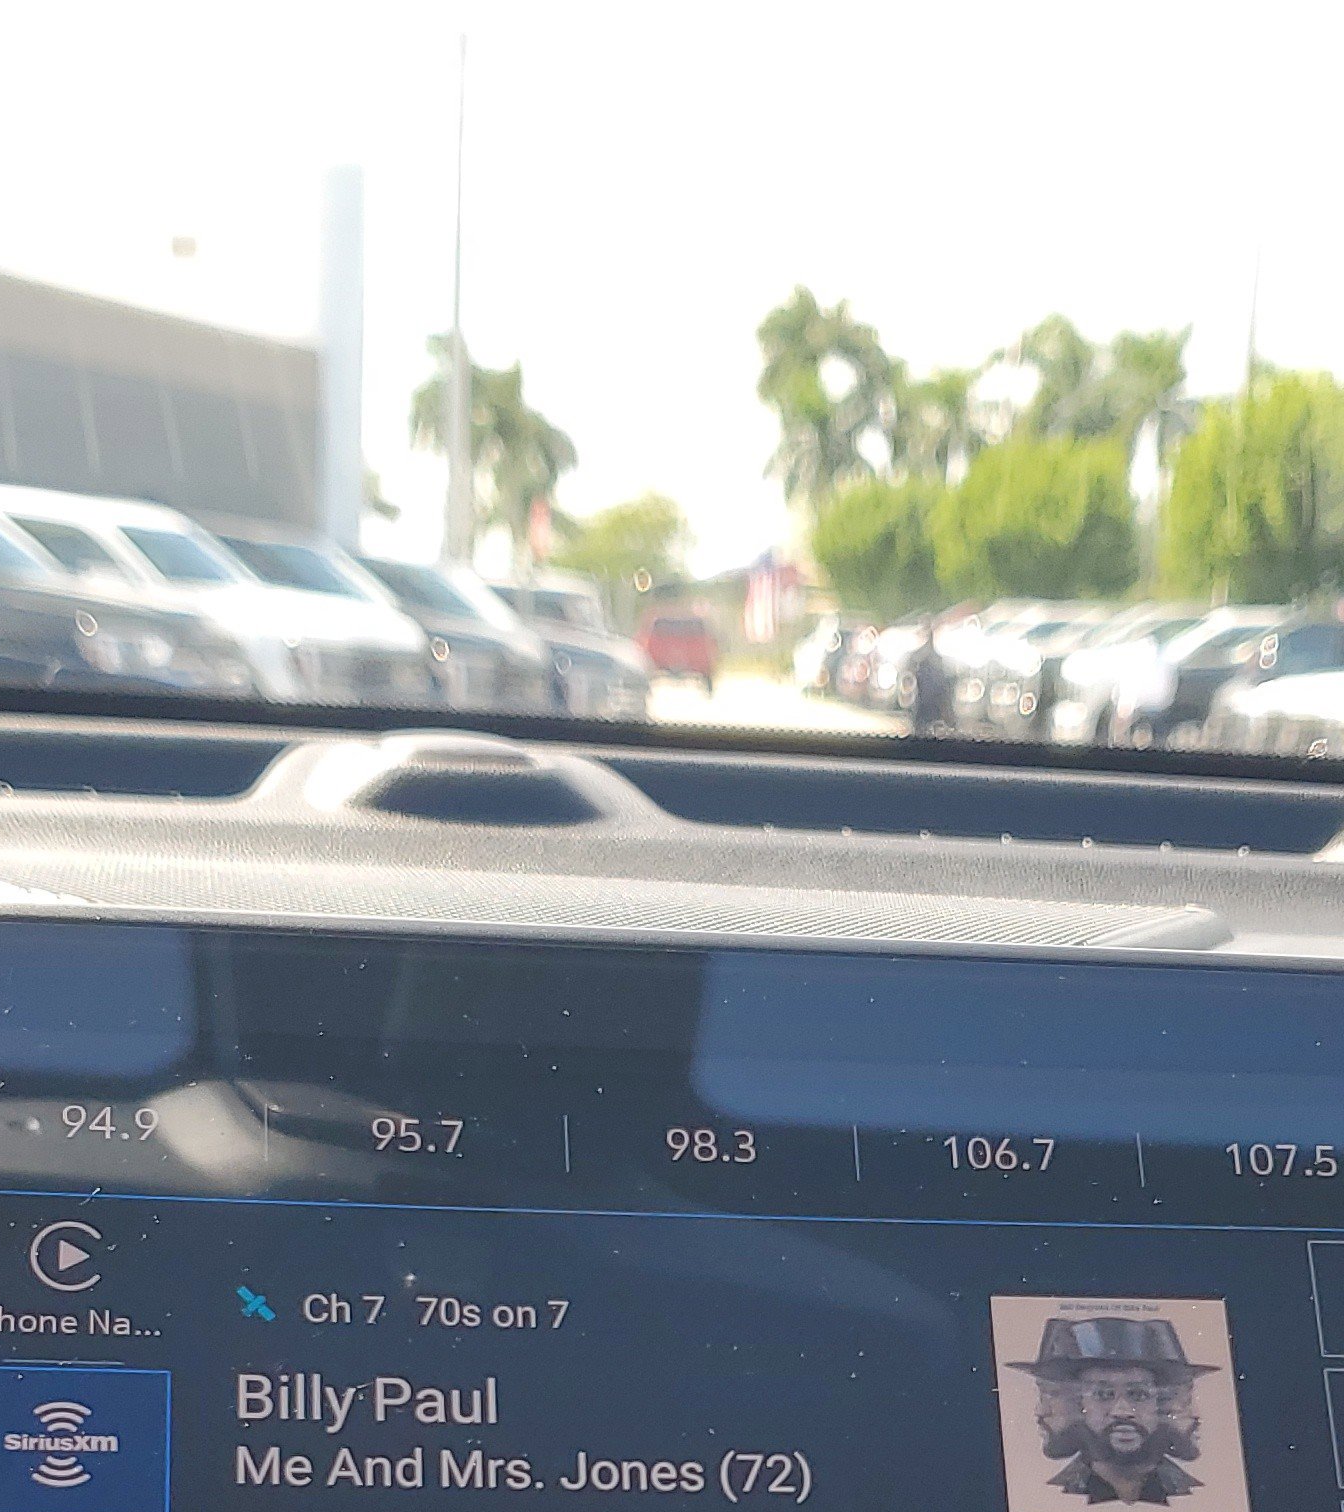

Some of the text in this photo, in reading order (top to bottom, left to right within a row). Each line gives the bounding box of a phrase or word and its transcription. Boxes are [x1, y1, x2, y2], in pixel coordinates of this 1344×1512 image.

[60, 1105, 160, 1143] 94.9
[370, 1117, 463, 1155] 95.7
[665, 1128, 757, 1164] 98.3
[944, 1135, 1056, 1172] 106.7
[1225, 1143, 1338, 1178] 107.5
[302, 1294, 570, 1328] Ch 7 70s on 7
[236, 1373, 499, 1433] Billy Paul
[235, 1447, 812, 1502] Me And Mrs. Jones (72)
